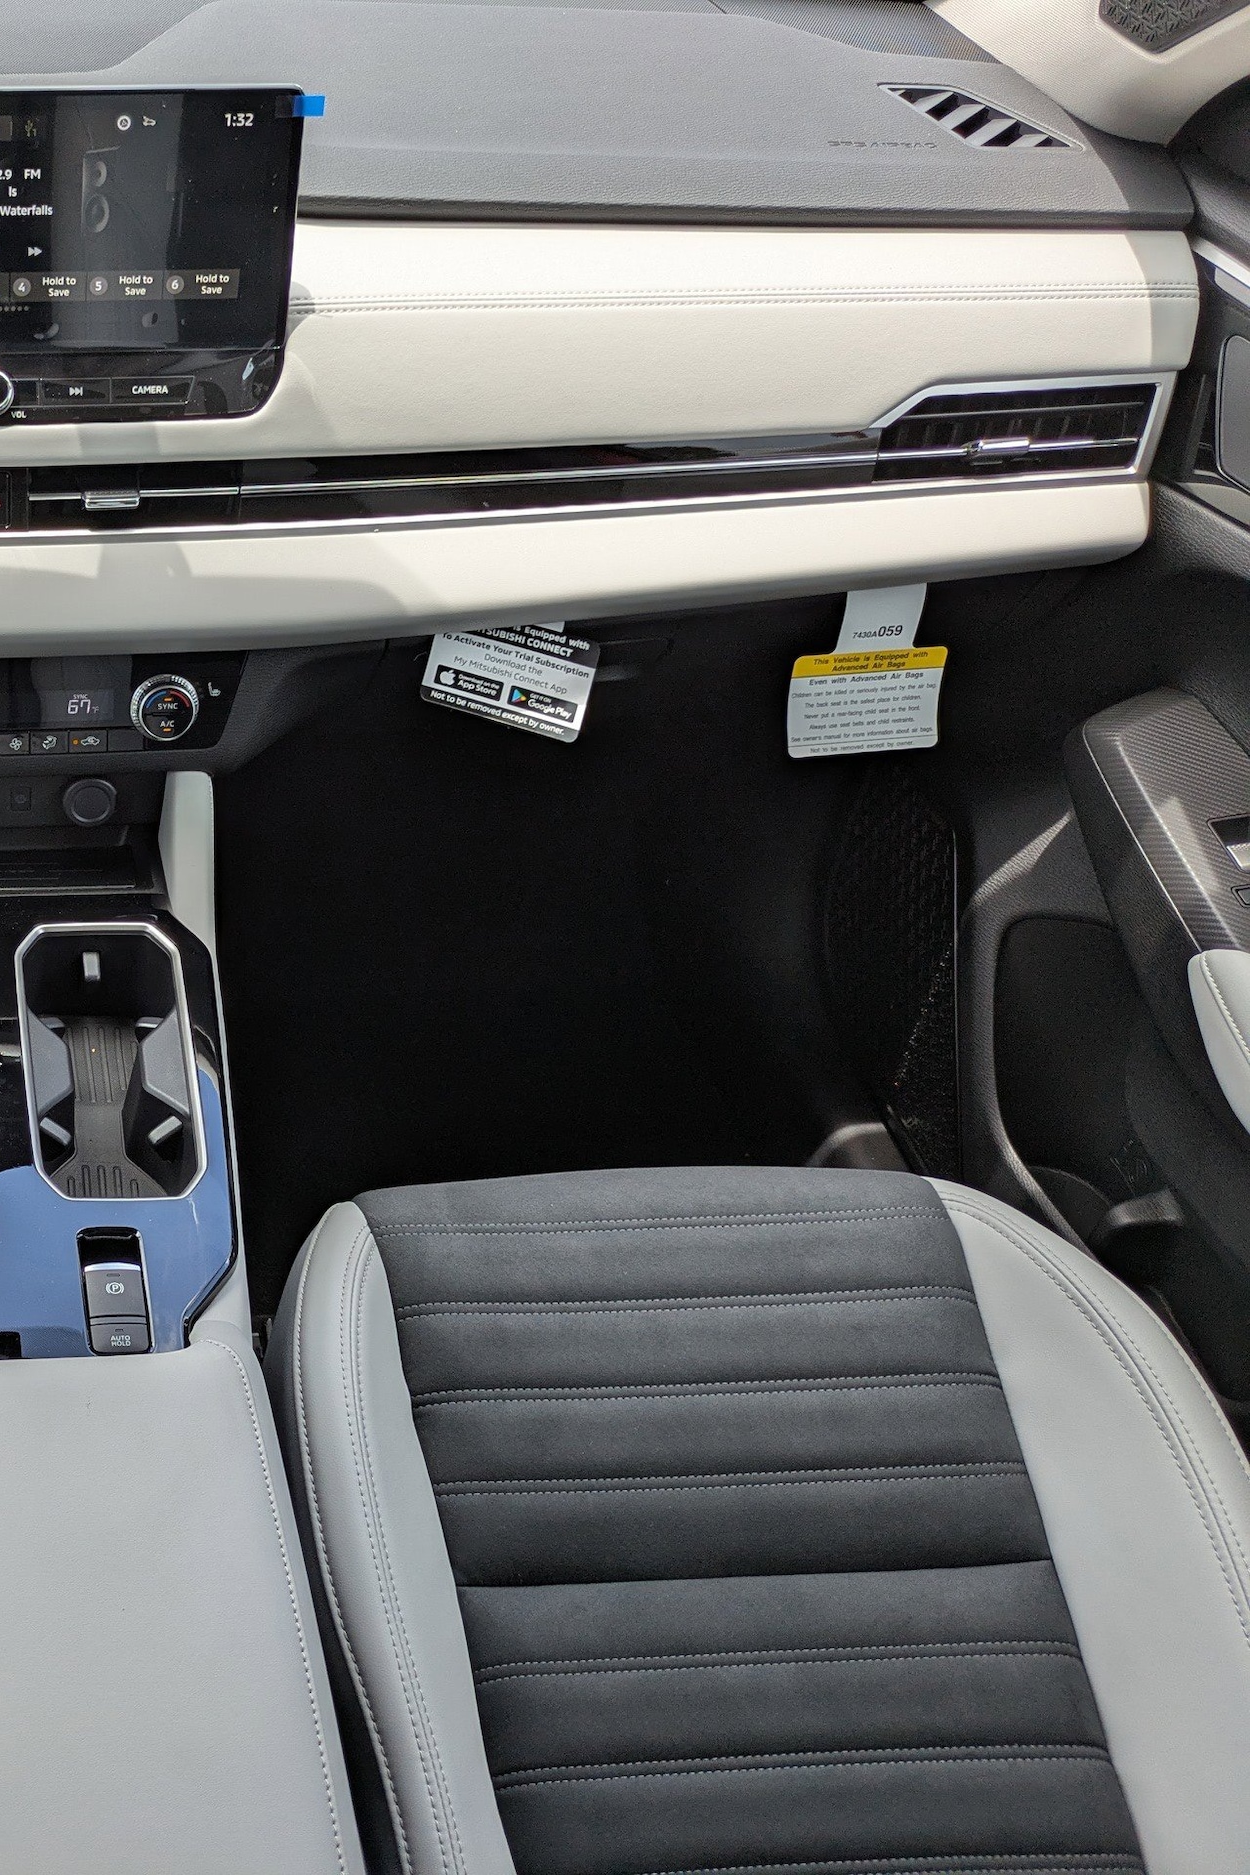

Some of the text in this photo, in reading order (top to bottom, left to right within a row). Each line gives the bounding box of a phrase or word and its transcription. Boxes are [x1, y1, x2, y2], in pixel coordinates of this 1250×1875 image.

[224, 113, 254, 127] 1:32
[23, 168, 41, 180] FM
[42, 276, 77, 286] Hold to
[119, 275, 153, 285] Hold to
[195, 274, 230, 284] Hold to
[48, 288, 70, 297] Save
[124, 287, 147, 296] Save
[201, 286, 223, 295] Save
[131, 385, 169, 395] CAMERA
[10, 410, 27, 419] VOL
[523, 626, 568, 644] Equipped
[568, 638, 591, 651] with
[851, 624, 904, 640] 7430A059
[526, 638, 574, 658] CONNECT
[453, 635, 491, 651] Activate
[493, 644, 514, 656] Your
[514, 650, 534, 662] Trial
[534, 656, 590, 679] Subscription
[813, 658, 830, 666] This
[833, 655, 861, 664] Vehicle
[873, 652, 910, 662] Equipped
[912, 651, 929, 659] with
[484, 653, 543, 677] Download the
[831, 663, 869, 672] Advanced
[886, 661, 906, 669] Bags
[453, 656, 568, 695] My Mitsubishi Connect App
[808, 678, 828, 686] Even
[831, 676, 847, 684] with
[849, 673, 887, 683] Advanced
[904, 671, 924, 680] Bags
[457, 679, 497, 697] App Store
[157, 702, 179, 710] SYNC
[527, 699, 573, 720] Google Play
[429, 690, 565, 736] Not to be removed except by owner.
[159, 720, 175, 728] A/C
